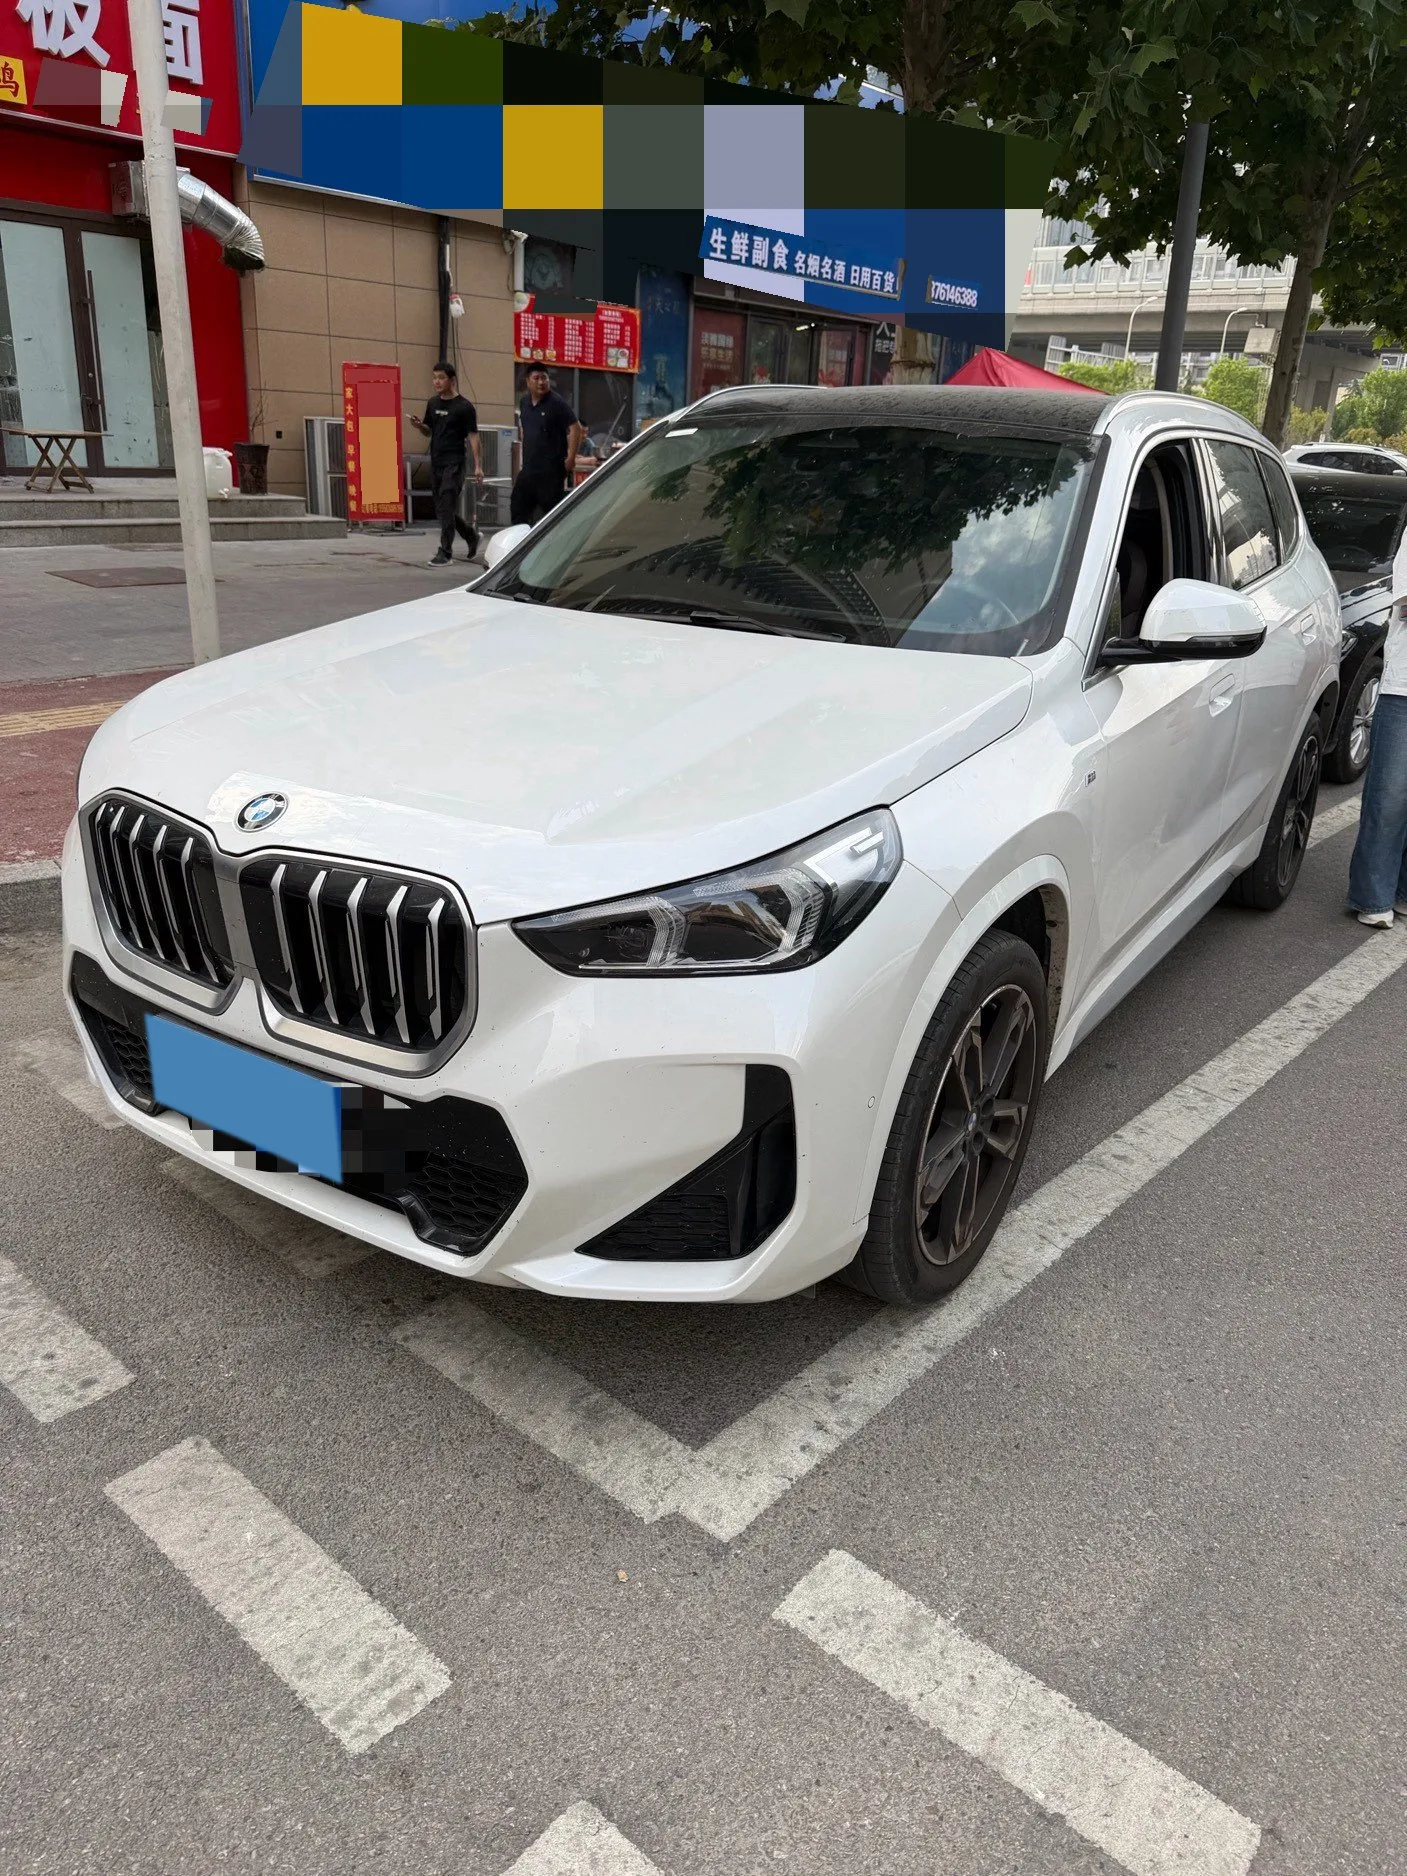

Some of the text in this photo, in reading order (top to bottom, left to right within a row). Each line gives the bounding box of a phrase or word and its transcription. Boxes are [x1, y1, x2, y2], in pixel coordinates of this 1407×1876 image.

[709, 227, 896, 293] 生鲜副食 名烟名酒 日用百货
